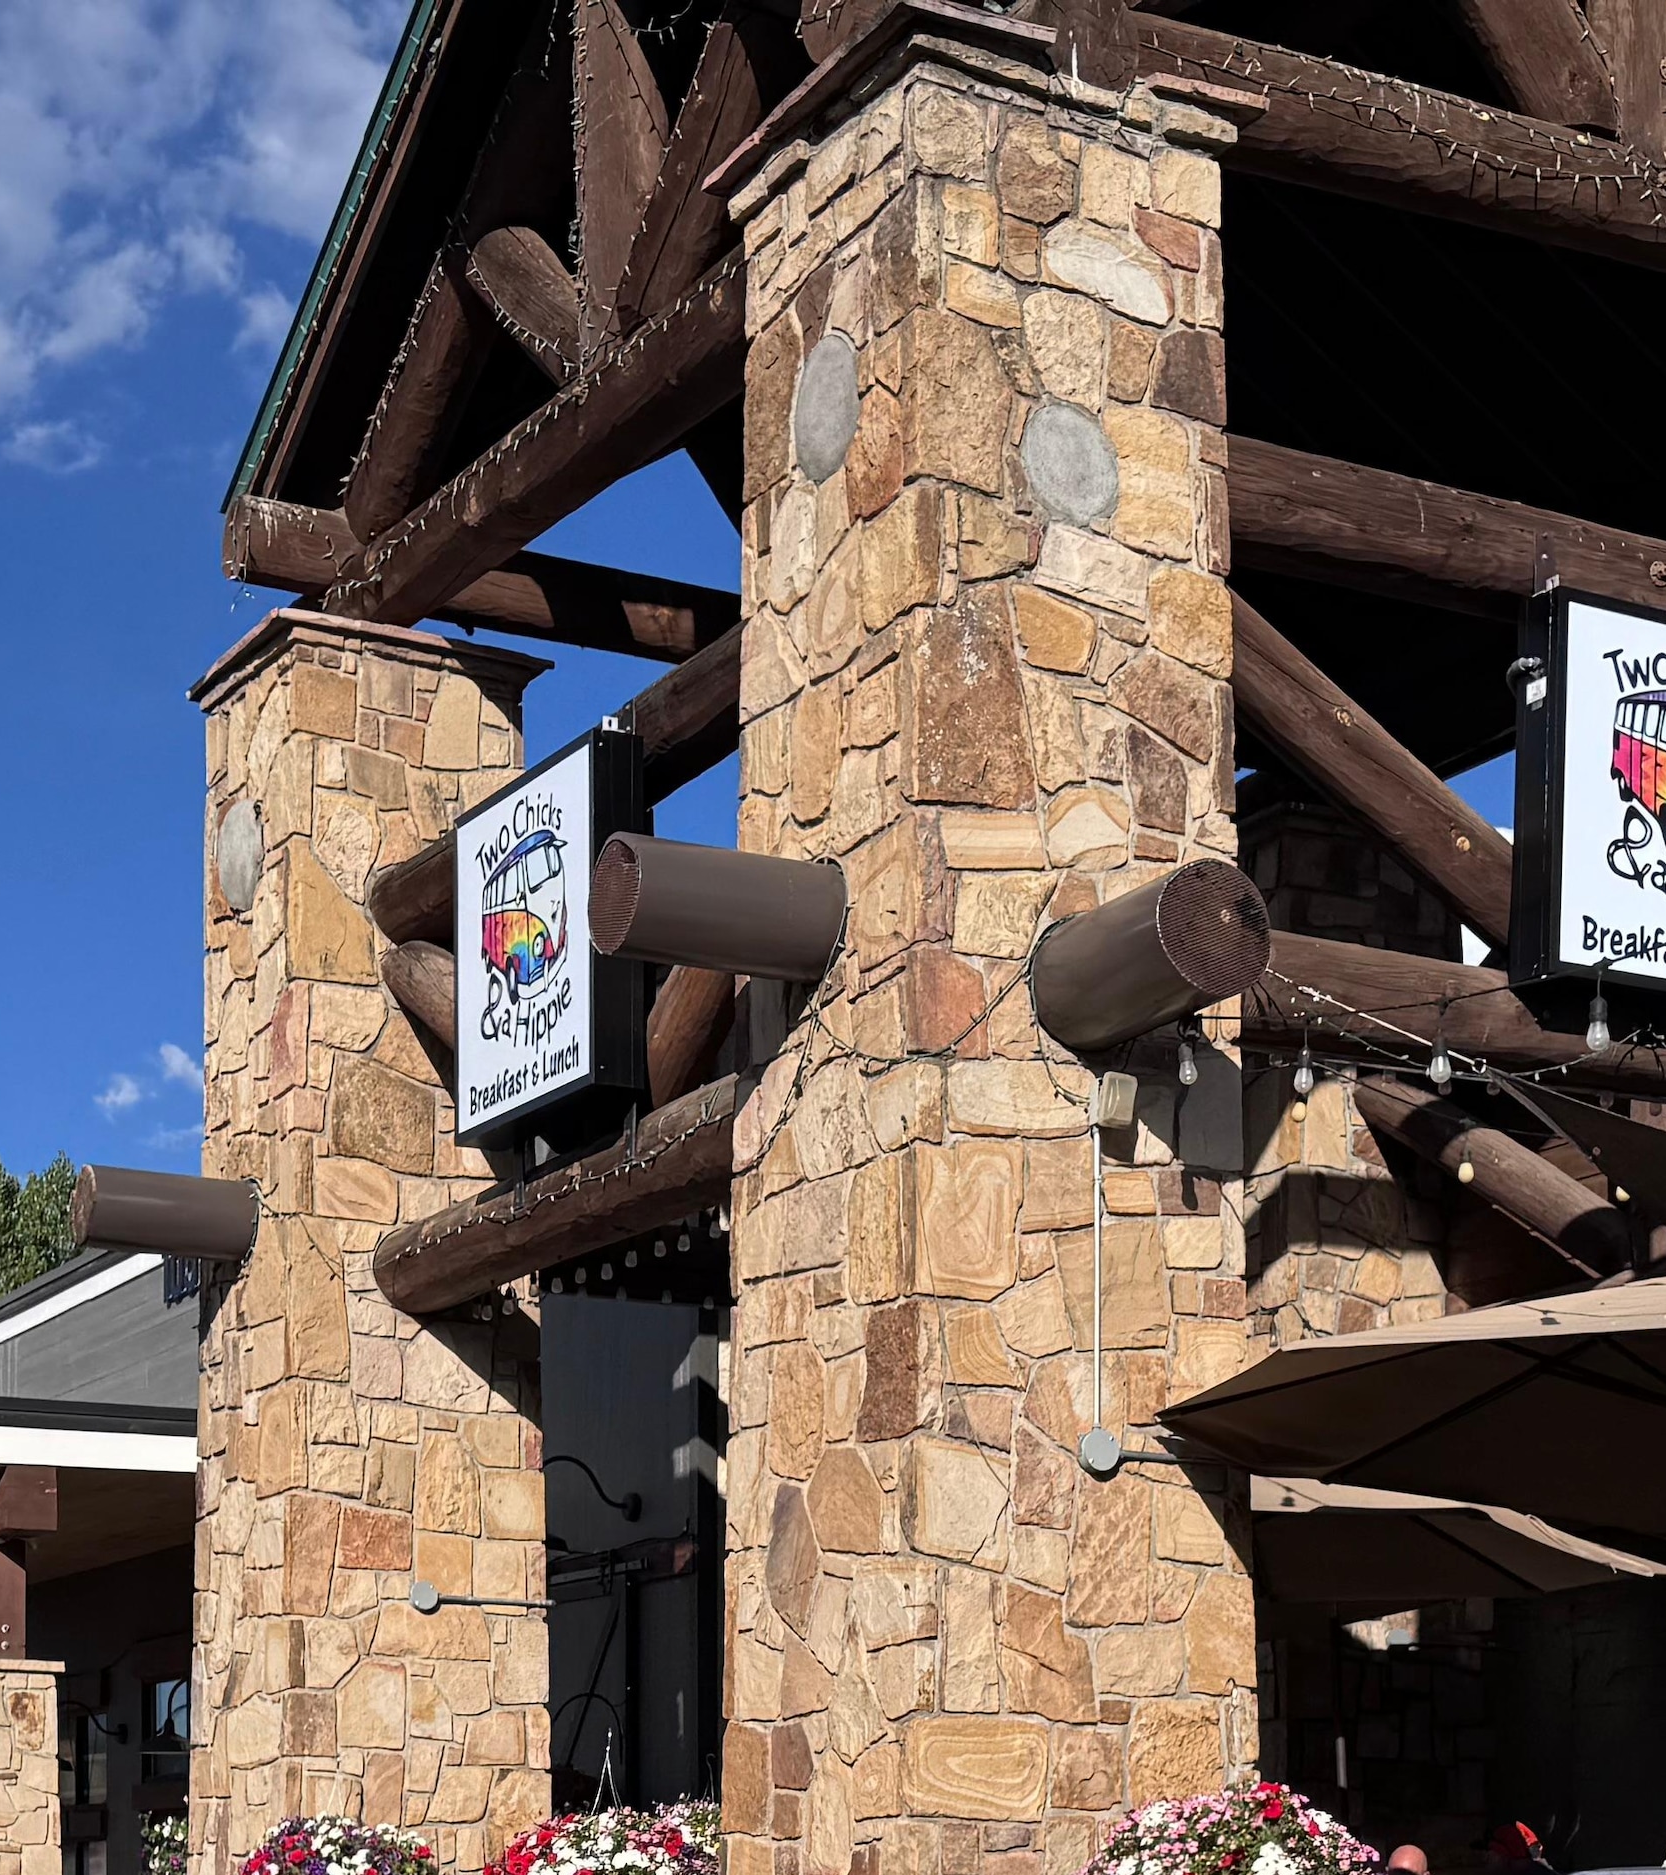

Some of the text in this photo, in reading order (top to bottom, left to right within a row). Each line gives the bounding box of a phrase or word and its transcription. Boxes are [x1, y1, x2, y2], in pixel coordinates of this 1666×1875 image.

[475, 793, 563, 881] Two Chicks
[513, 977, 572, 1054] Hippie
[469, 1035, 580, 1117] Breakfast & Lunch
